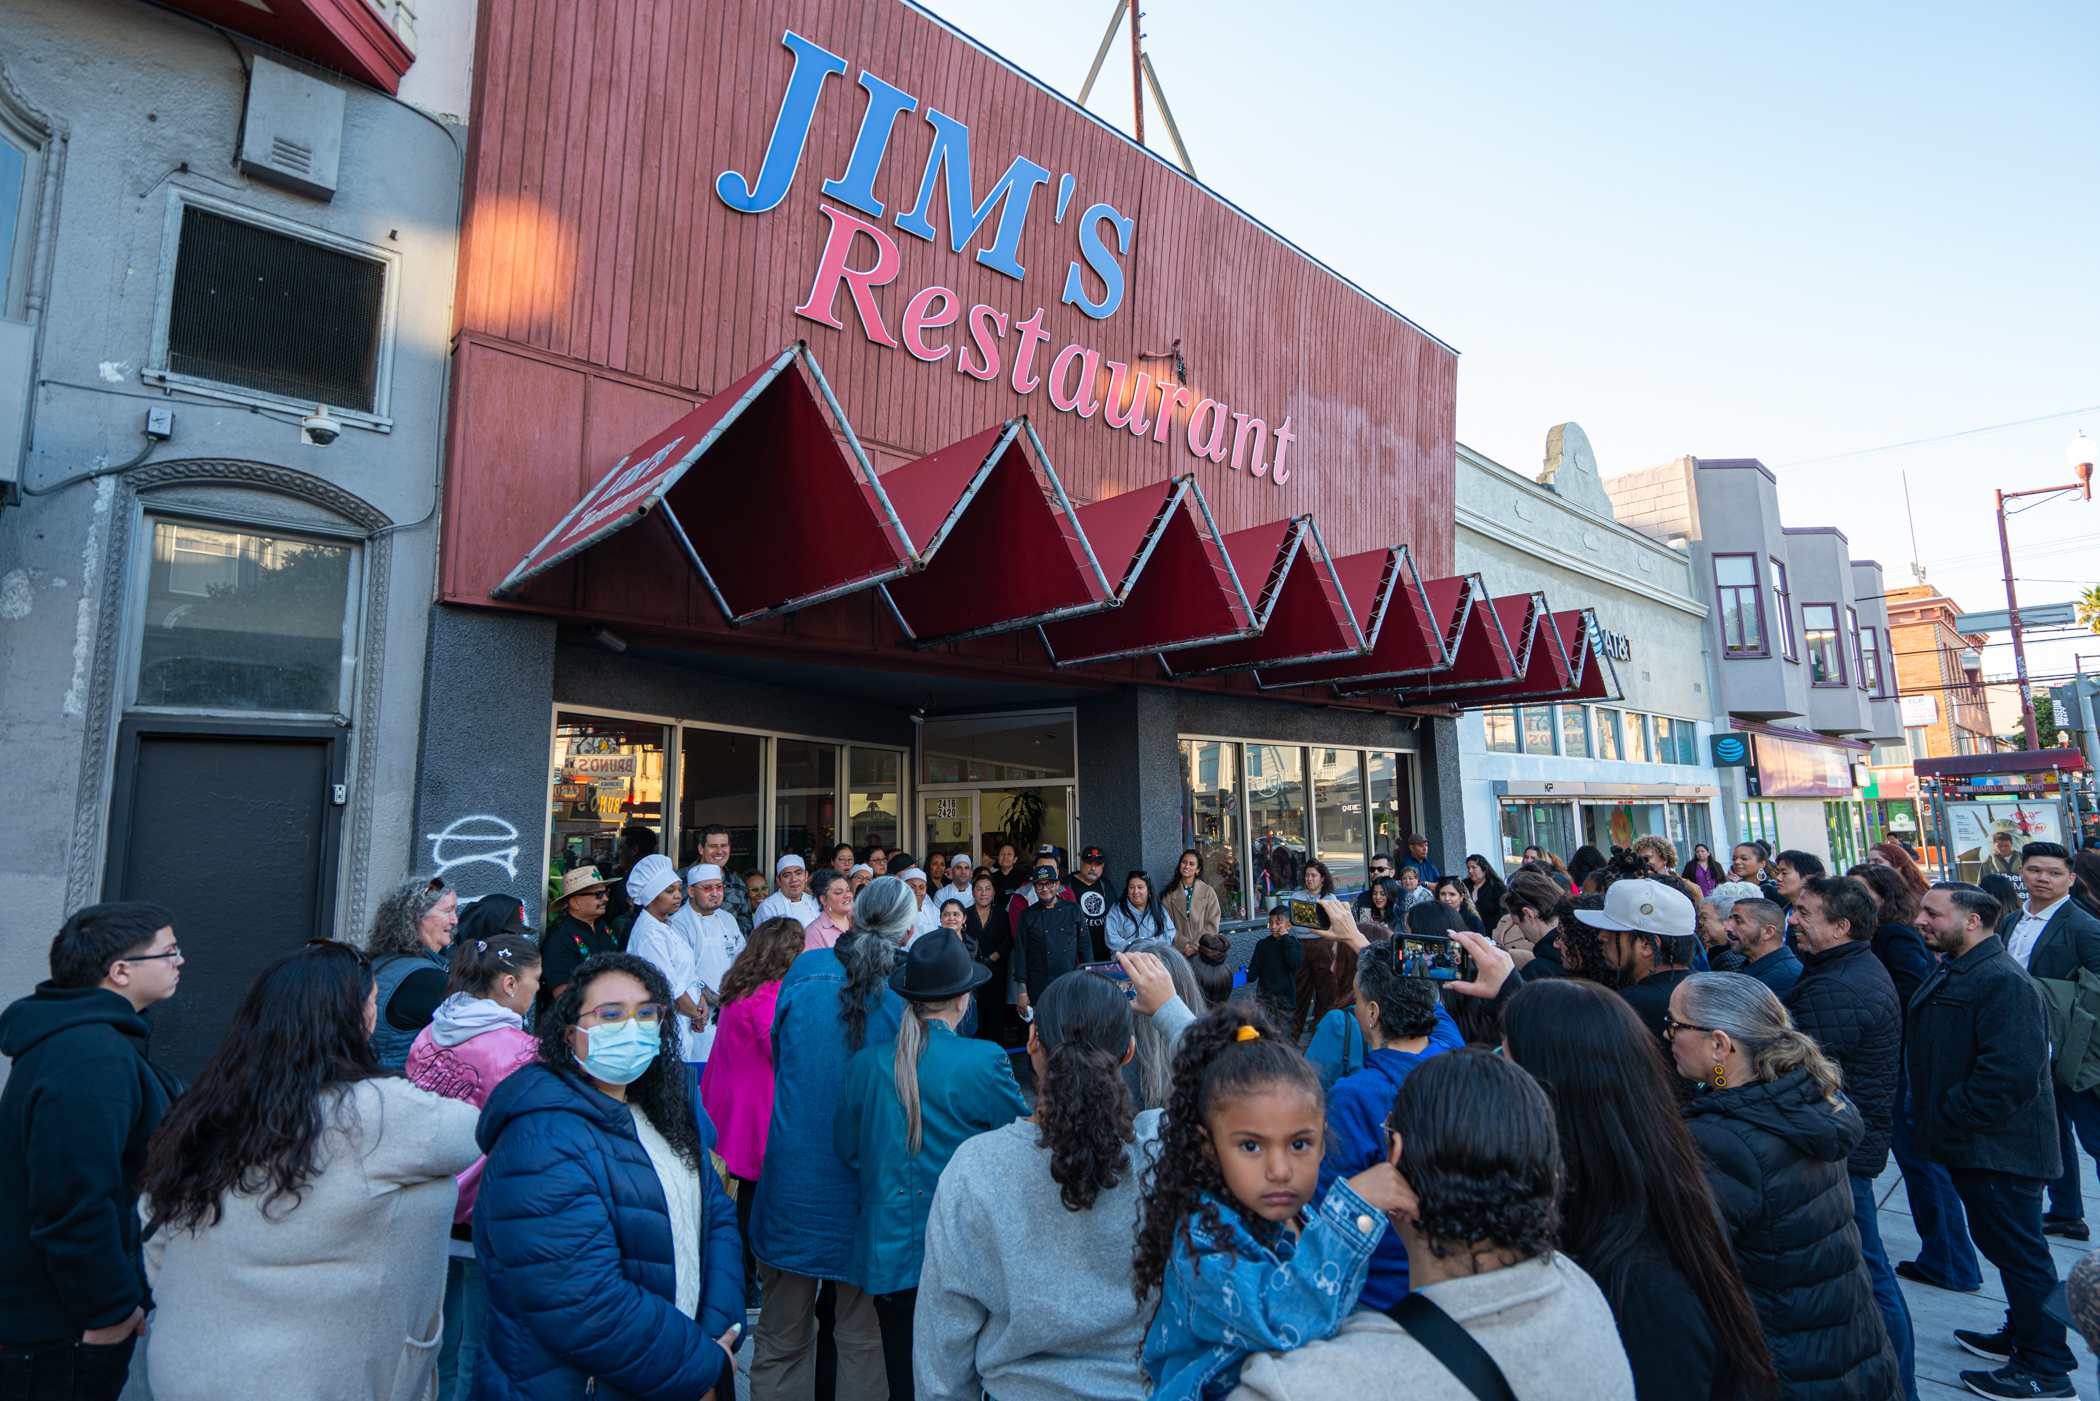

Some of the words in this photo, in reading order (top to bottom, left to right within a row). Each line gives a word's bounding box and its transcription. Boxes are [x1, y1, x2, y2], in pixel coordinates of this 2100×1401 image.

[715, 29, 1135, 320] JIM'S
[794, 203, 1297, 486] Restaurant
[1601, 629, 1633, 662] AT&T
[2052, 699, 2064, 727] MUSEUM
[2019, 783, 2044, 791] RAPID
[937, 808, 956, 818] 2420
[938, 799, 956, 809] 2416
